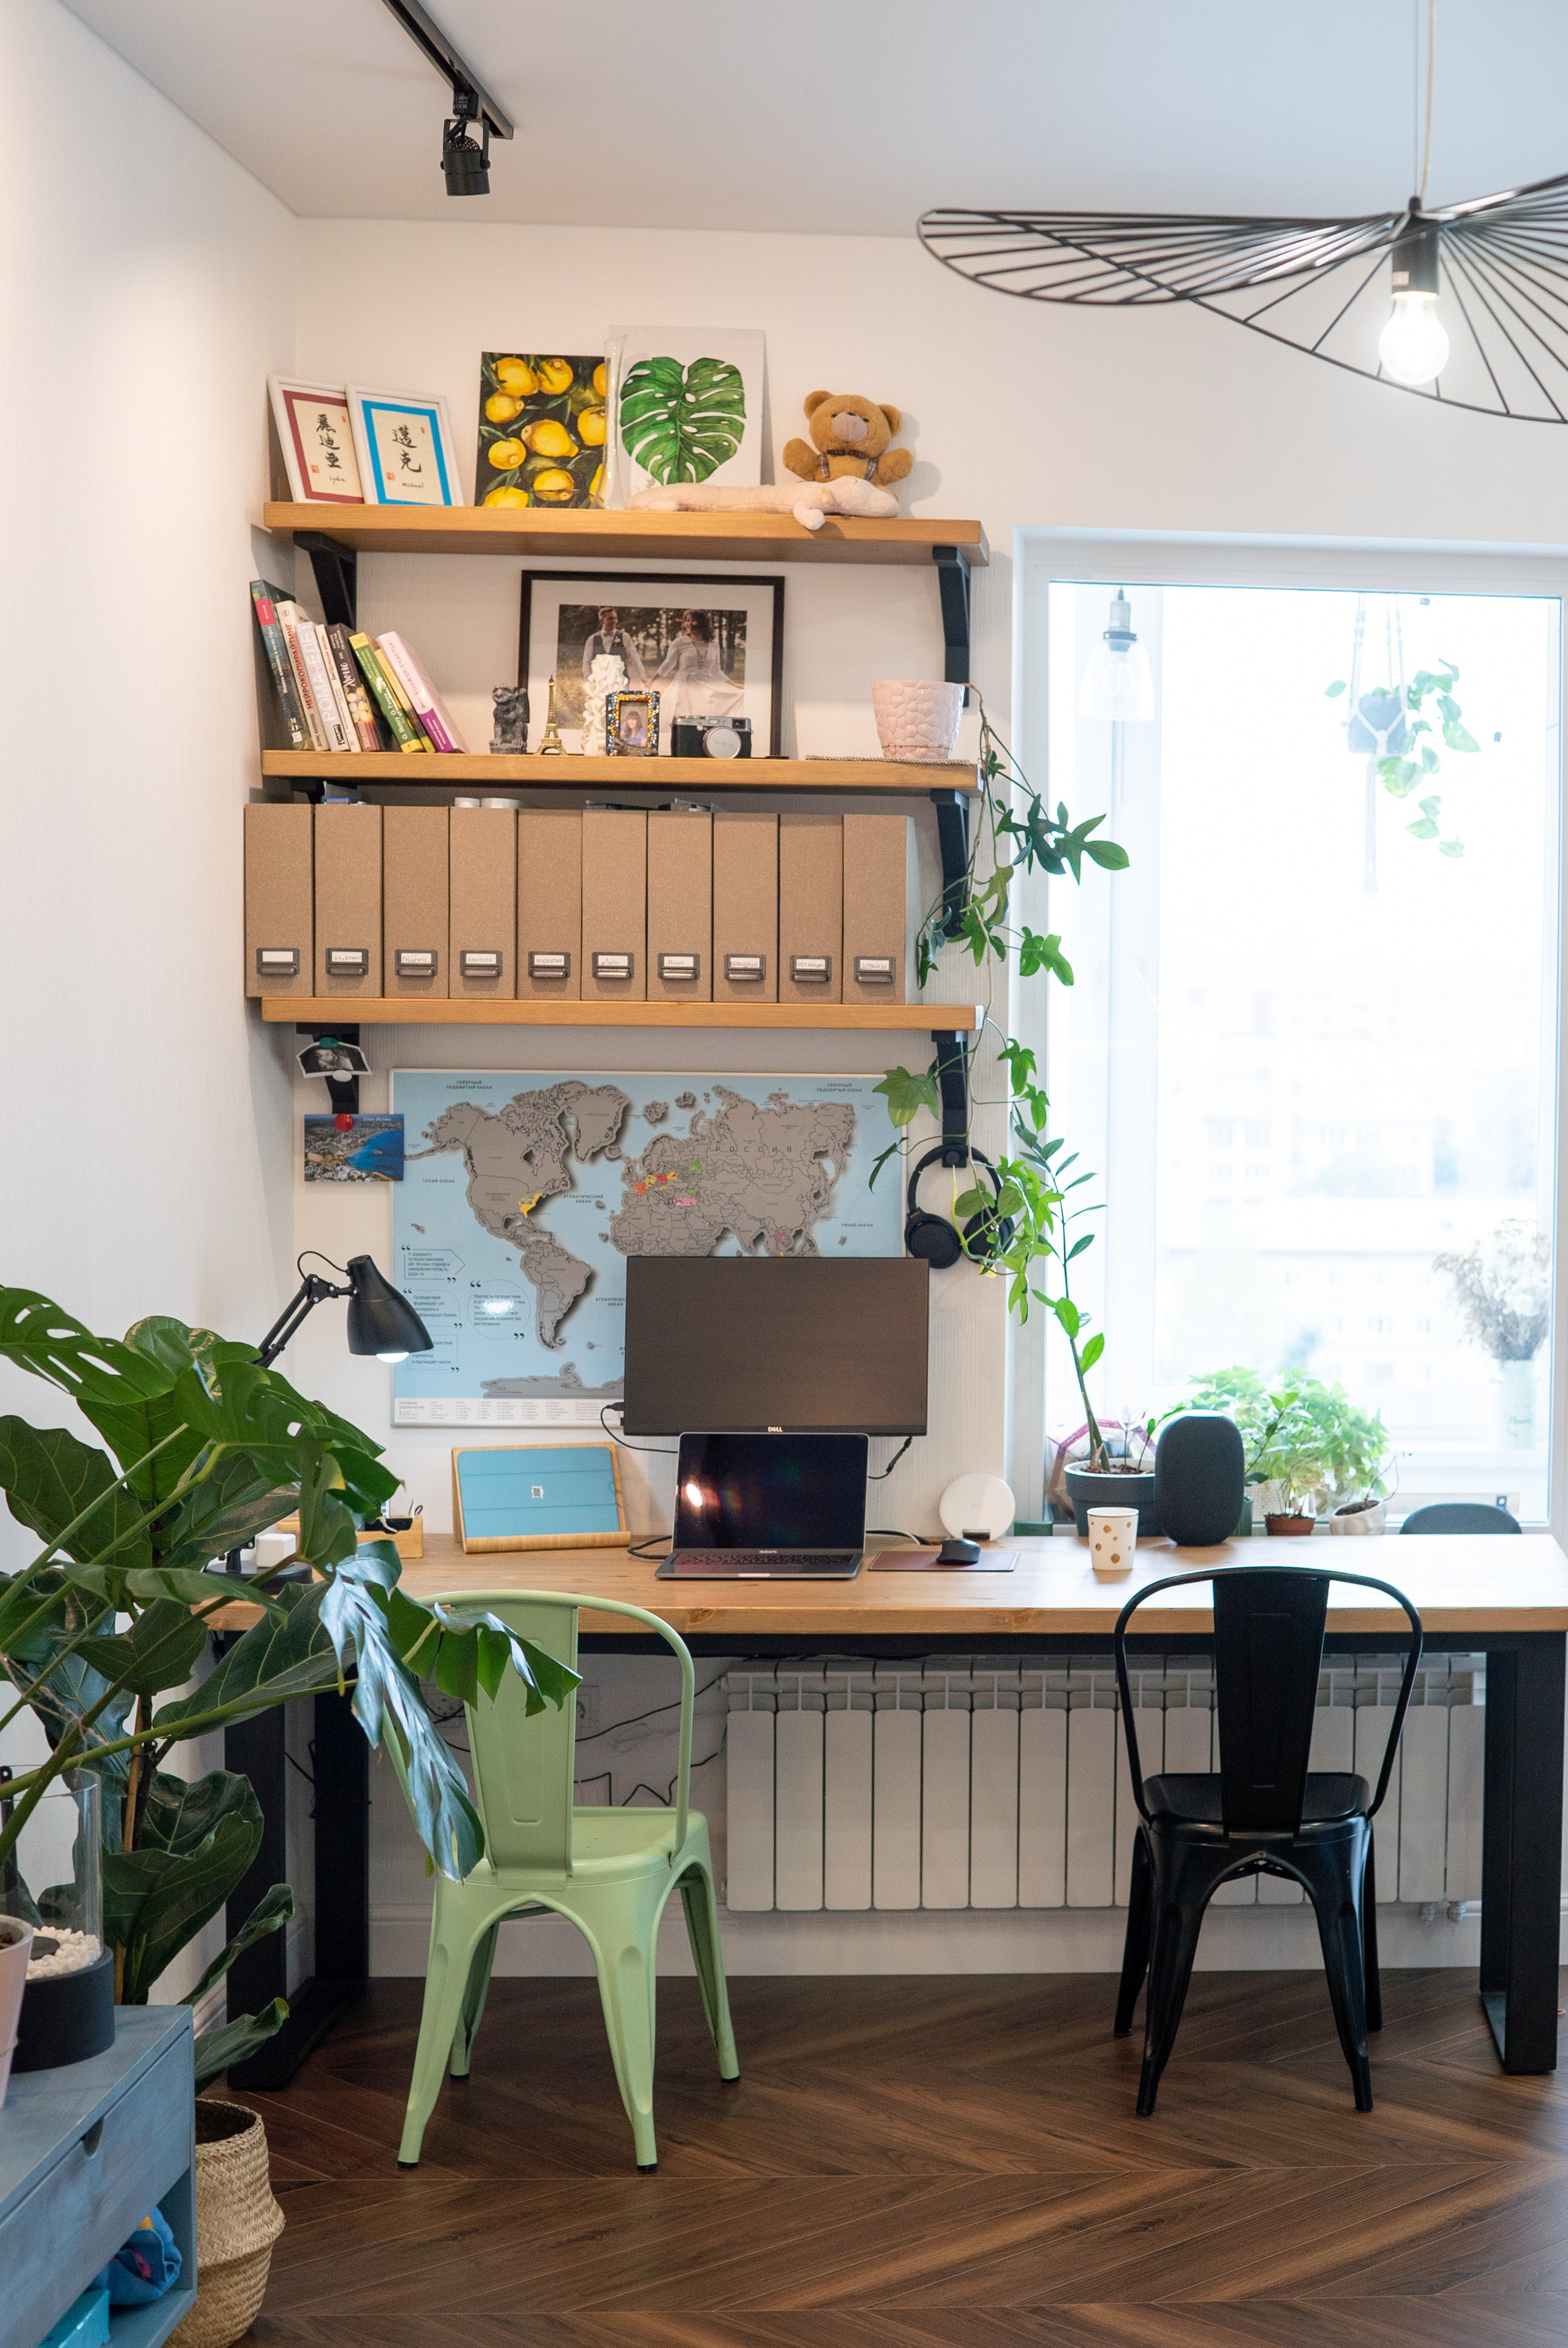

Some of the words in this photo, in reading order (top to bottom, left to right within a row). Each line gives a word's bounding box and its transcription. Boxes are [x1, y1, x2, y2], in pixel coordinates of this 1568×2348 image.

[283, 622, 314, 709] НЕЙРОКОПИРАЙТИНГ
[309, 671, 339, 722] РОМА
[391, 715, 407, 733] Henry
